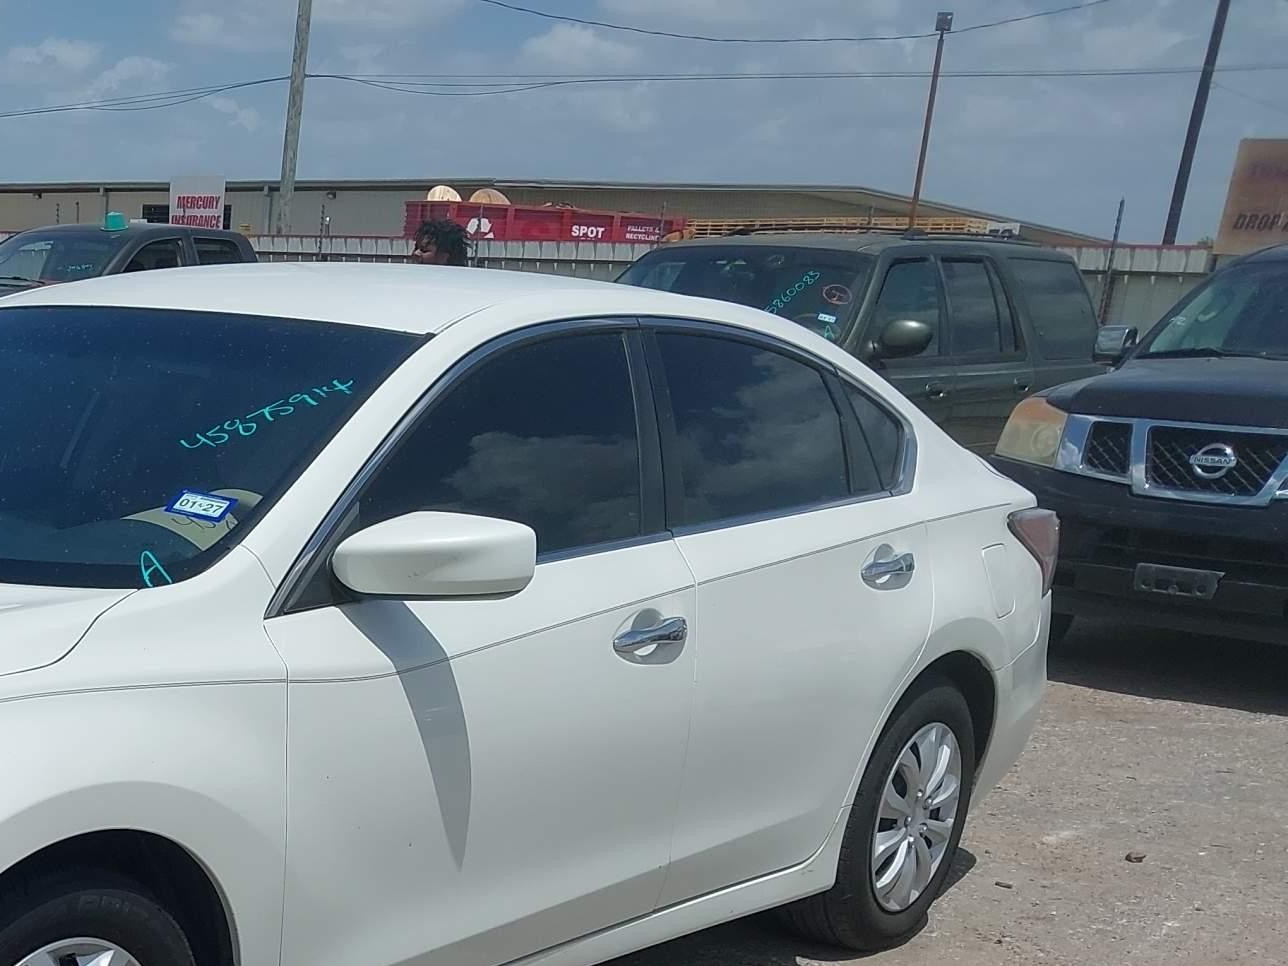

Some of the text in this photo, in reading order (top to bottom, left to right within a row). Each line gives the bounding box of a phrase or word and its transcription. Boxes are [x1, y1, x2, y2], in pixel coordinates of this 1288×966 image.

[176, 195, 221, 210] MERCURY
[171, 214, 221, 228] INSURANCE
[571, 225, 605, 238] SPOT
[180, 379, 354, 449] 45875914
[1193, 456, 1232, 466] NISSAN
[179, 498, 198, 509] 01
[202, 503, 223, 513] 27
[140, 551, 173, 587] A
